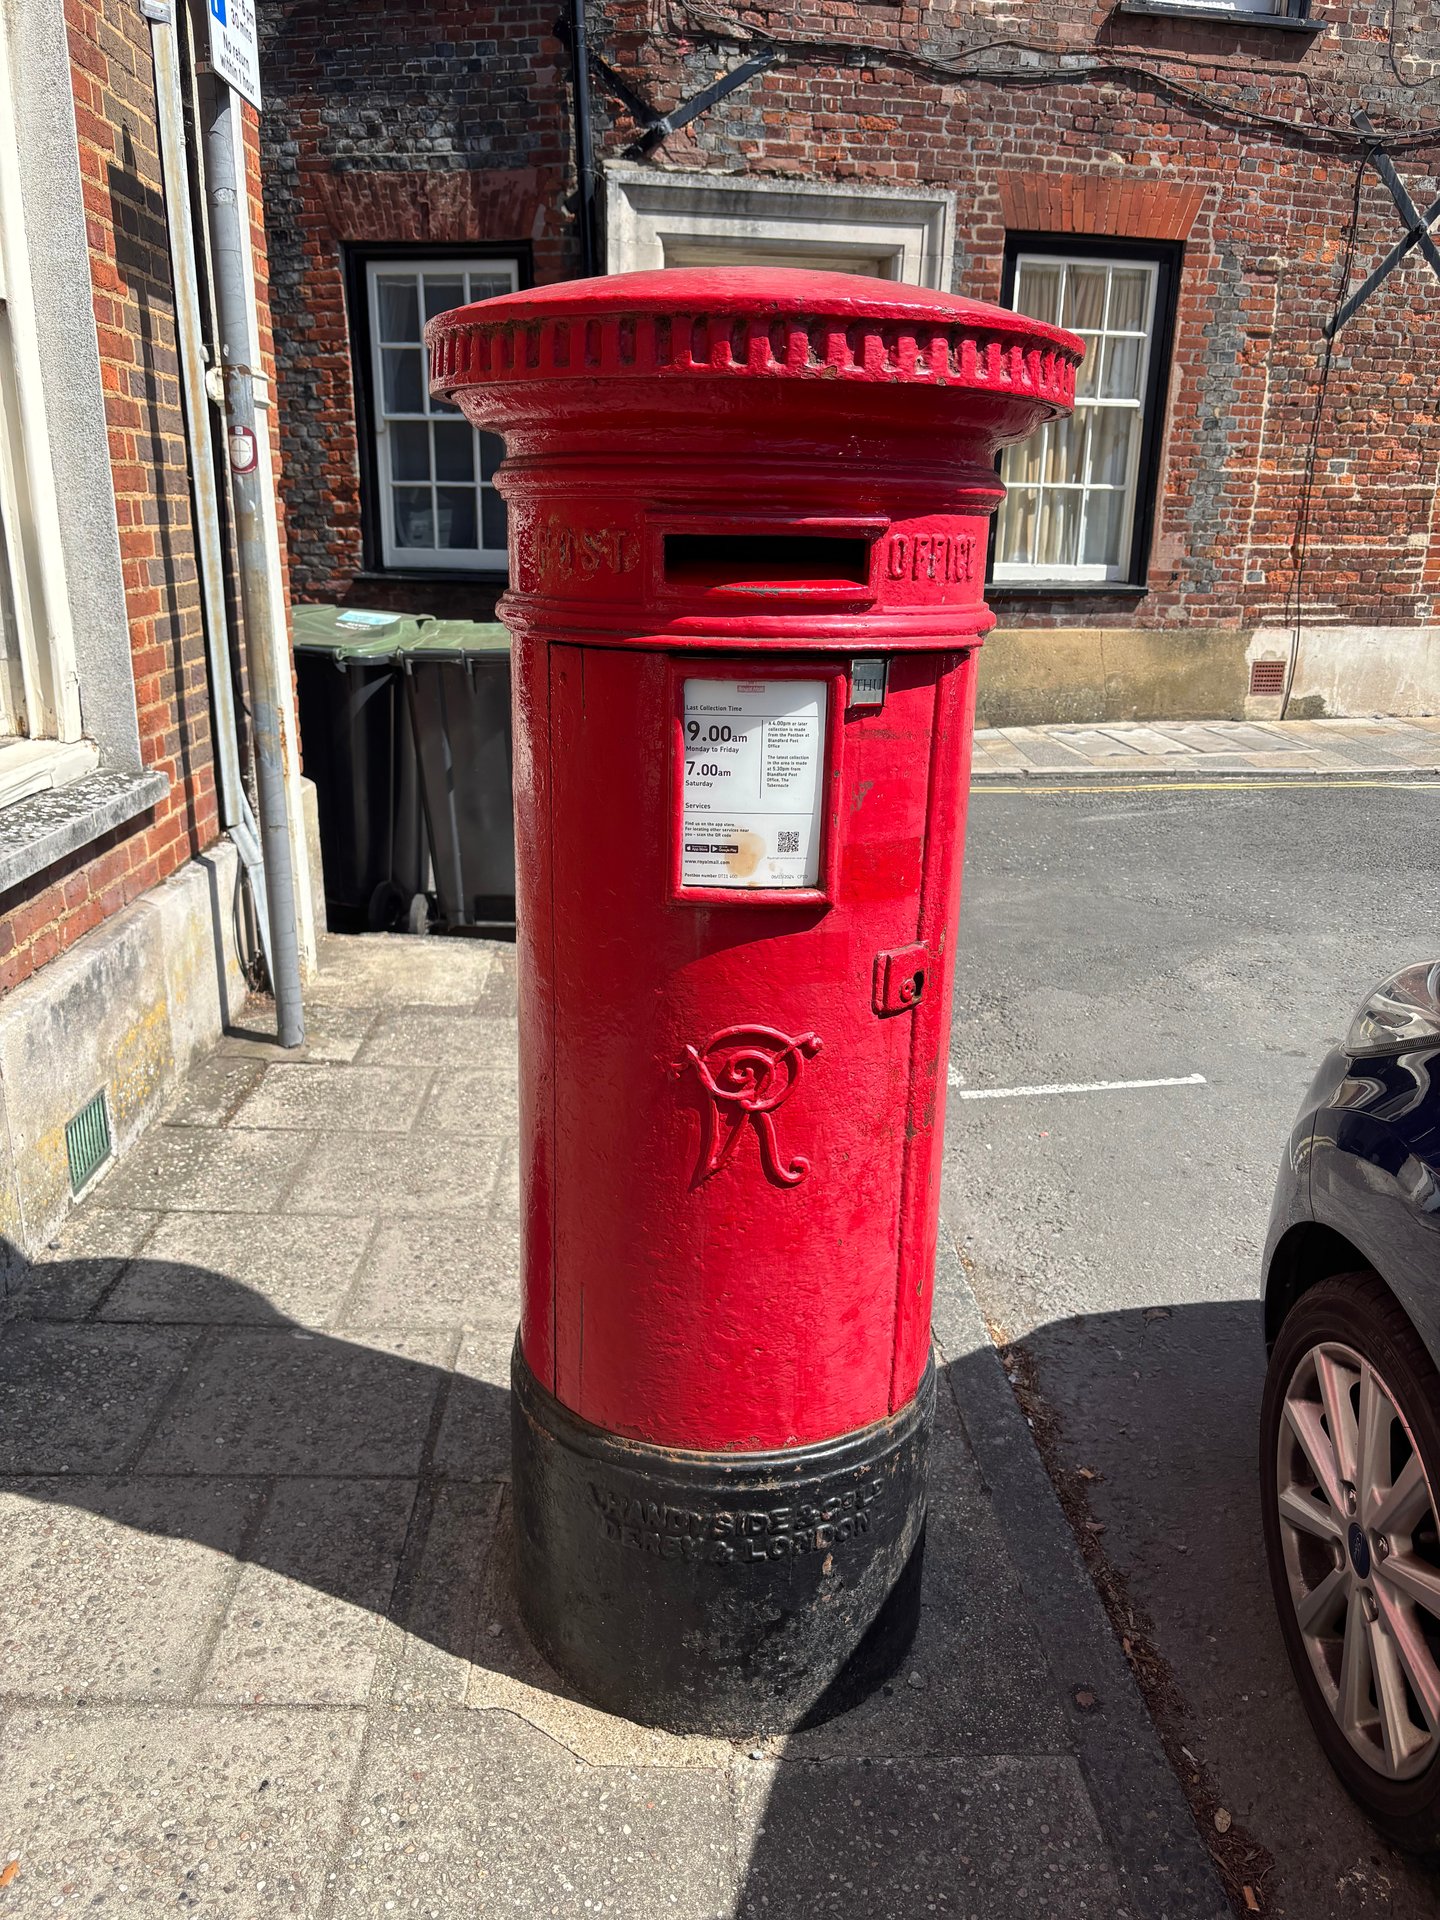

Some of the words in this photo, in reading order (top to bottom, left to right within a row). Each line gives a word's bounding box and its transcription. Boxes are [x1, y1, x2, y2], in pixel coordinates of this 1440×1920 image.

[231, 8, 239, 29] 30
[222, 31, 231, 54] No
[233, 45, 250, 74] return
[220, 53, 238, 80] within
[242, 71, 254, 96] hour
[855, 679, 882, 691] THU
[687, 720, 748, 742] 9.00am
[686, 745, 710, 753] Monday
[686, 761, 731, 776] 7.00am
[685, 780, 713, 788] Saturday
